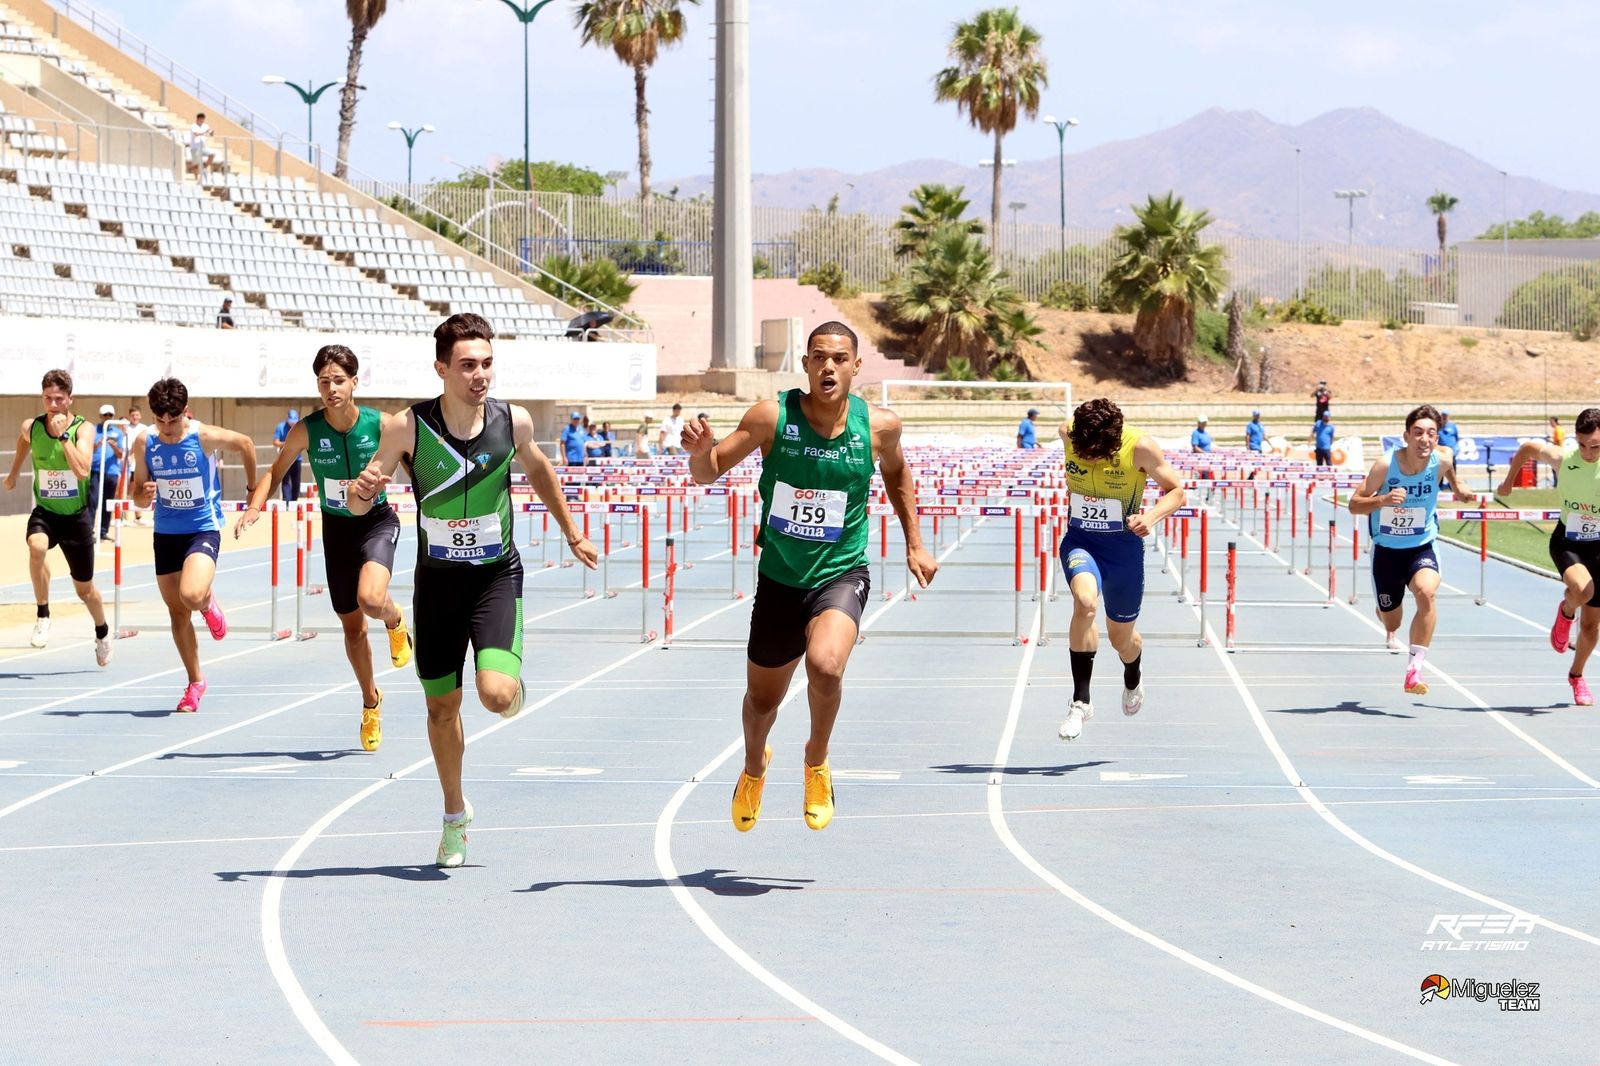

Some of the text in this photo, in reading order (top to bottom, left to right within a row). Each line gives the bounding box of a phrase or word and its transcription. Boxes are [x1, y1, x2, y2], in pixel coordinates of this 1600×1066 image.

[47, 480, 67, 489] 596
[168, 489, 193, 500] 200
[1564, 499, 1600, 514] nawt
[790, 505, 826, 524] 159
[1081, 506, 1109, 520] 324
[1080, 520, 1110, 530] Joma
[1391, 517, 1414, 527] 427
[784, 522, 826, 538] Joma
[452, 533, 477, 546] 83
[445, 547, 486, 559] Joma
